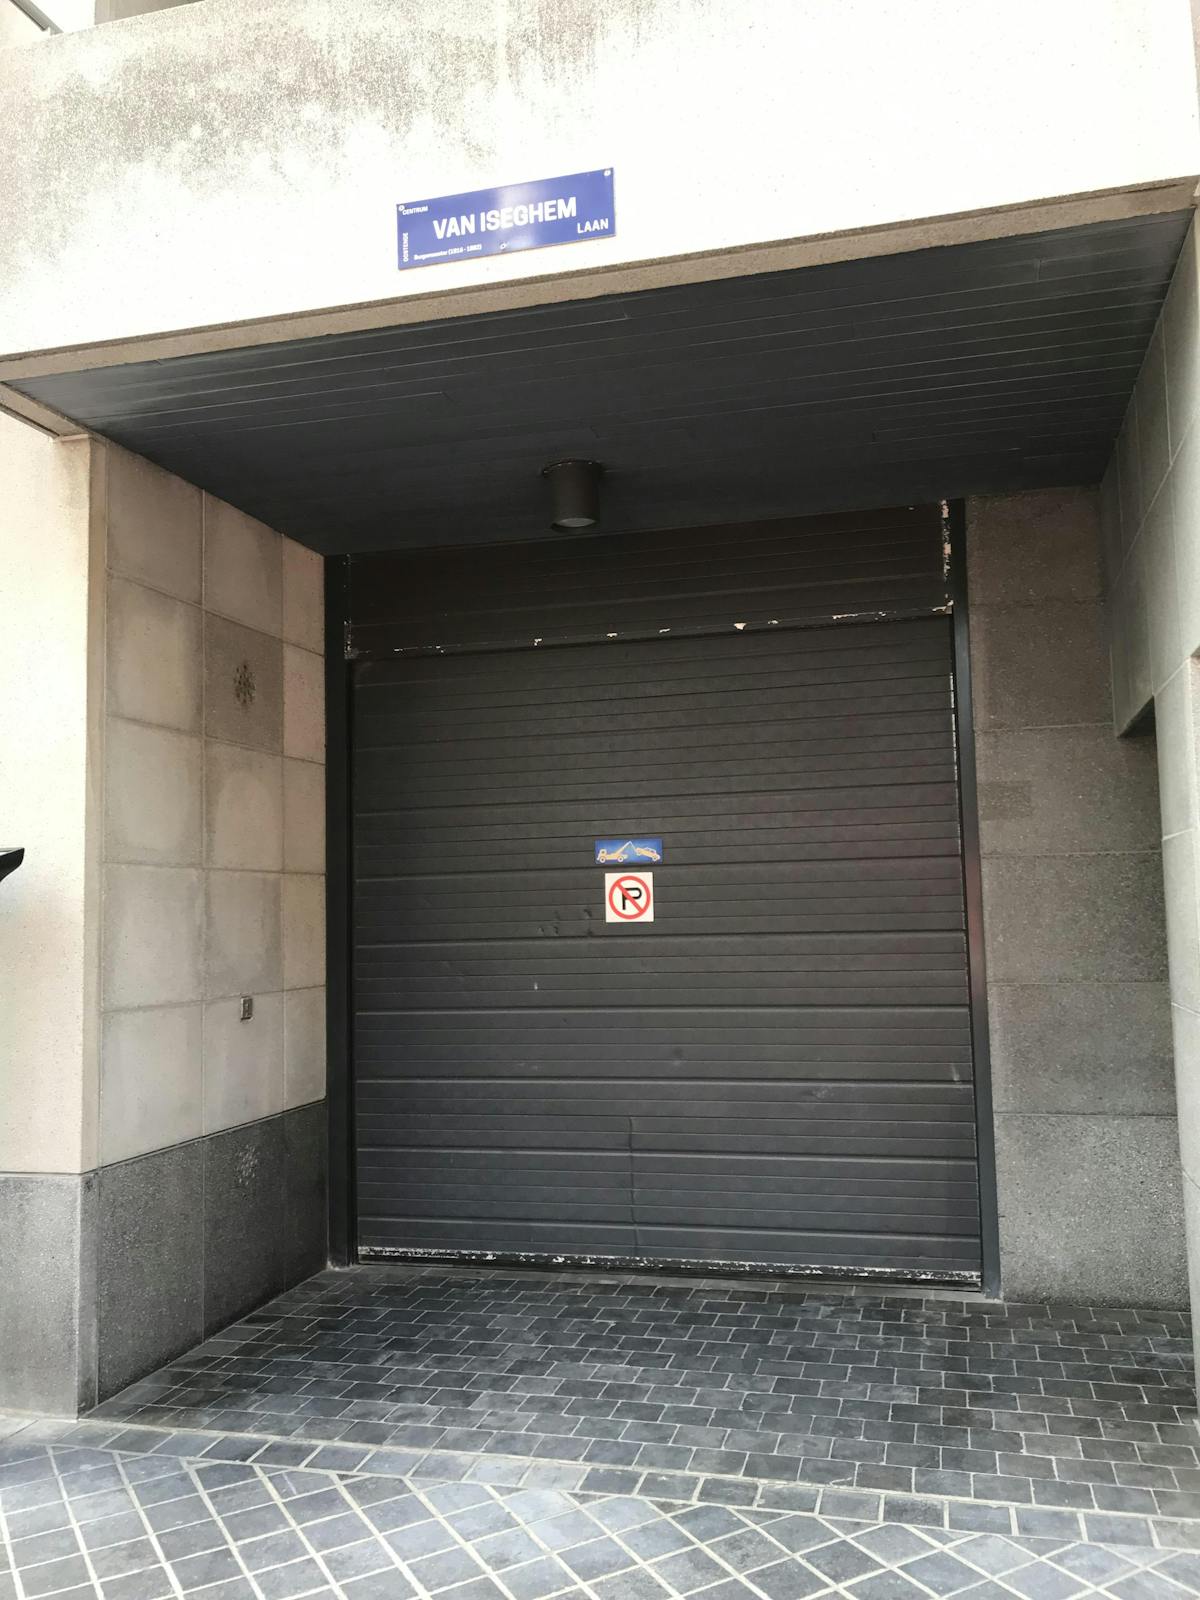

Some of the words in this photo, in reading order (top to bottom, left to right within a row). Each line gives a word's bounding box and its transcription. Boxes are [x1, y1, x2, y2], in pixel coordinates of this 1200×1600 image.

[402, 205, 428, 215] CENTRUM
[433, 214, 475, 239] VAN
[480, 196, 577, 232] ISEGHEM
[577, 218, 609, 233] LAAN
[622, 887, 642, 910] P
